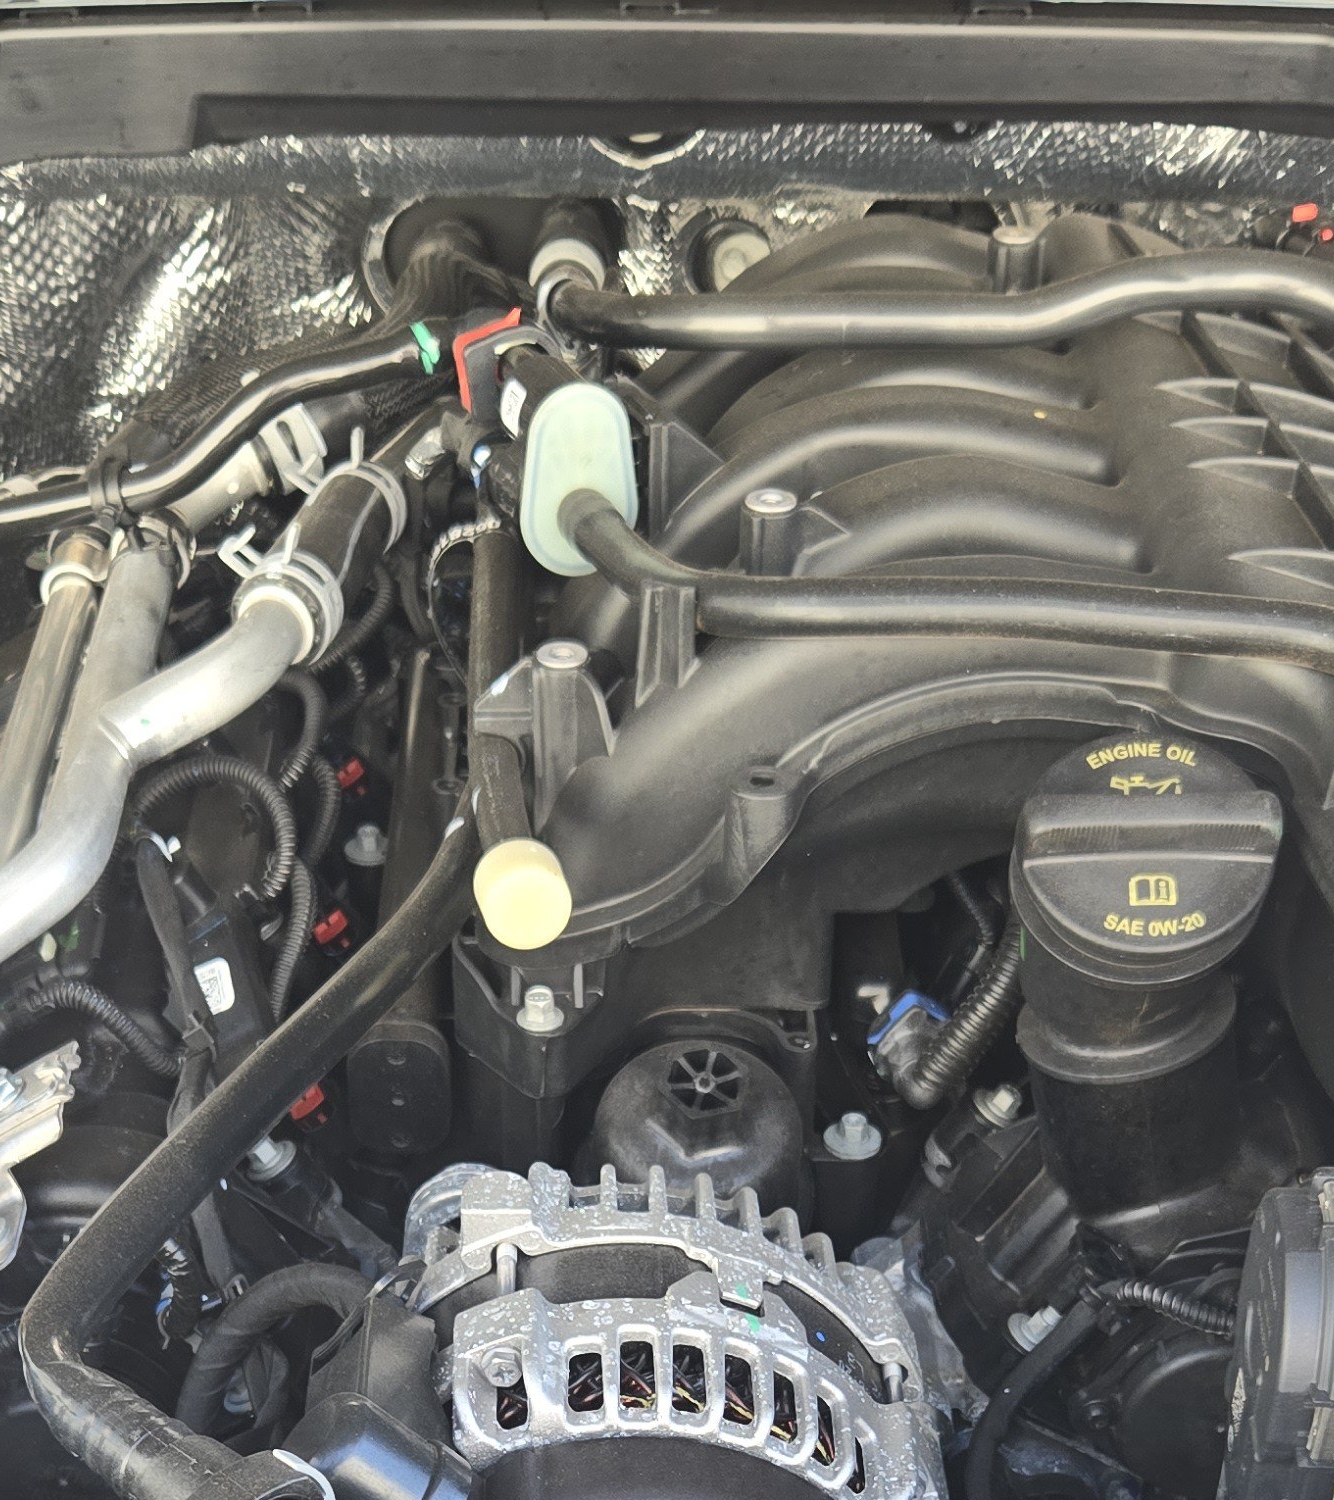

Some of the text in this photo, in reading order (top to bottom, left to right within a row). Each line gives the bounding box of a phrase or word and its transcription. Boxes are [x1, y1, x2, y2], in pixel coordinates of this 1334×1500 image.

[1085, 743, 1198, 771] ENGINE OIL
[1103, 910, 1207, 938] SAE 0W-20
